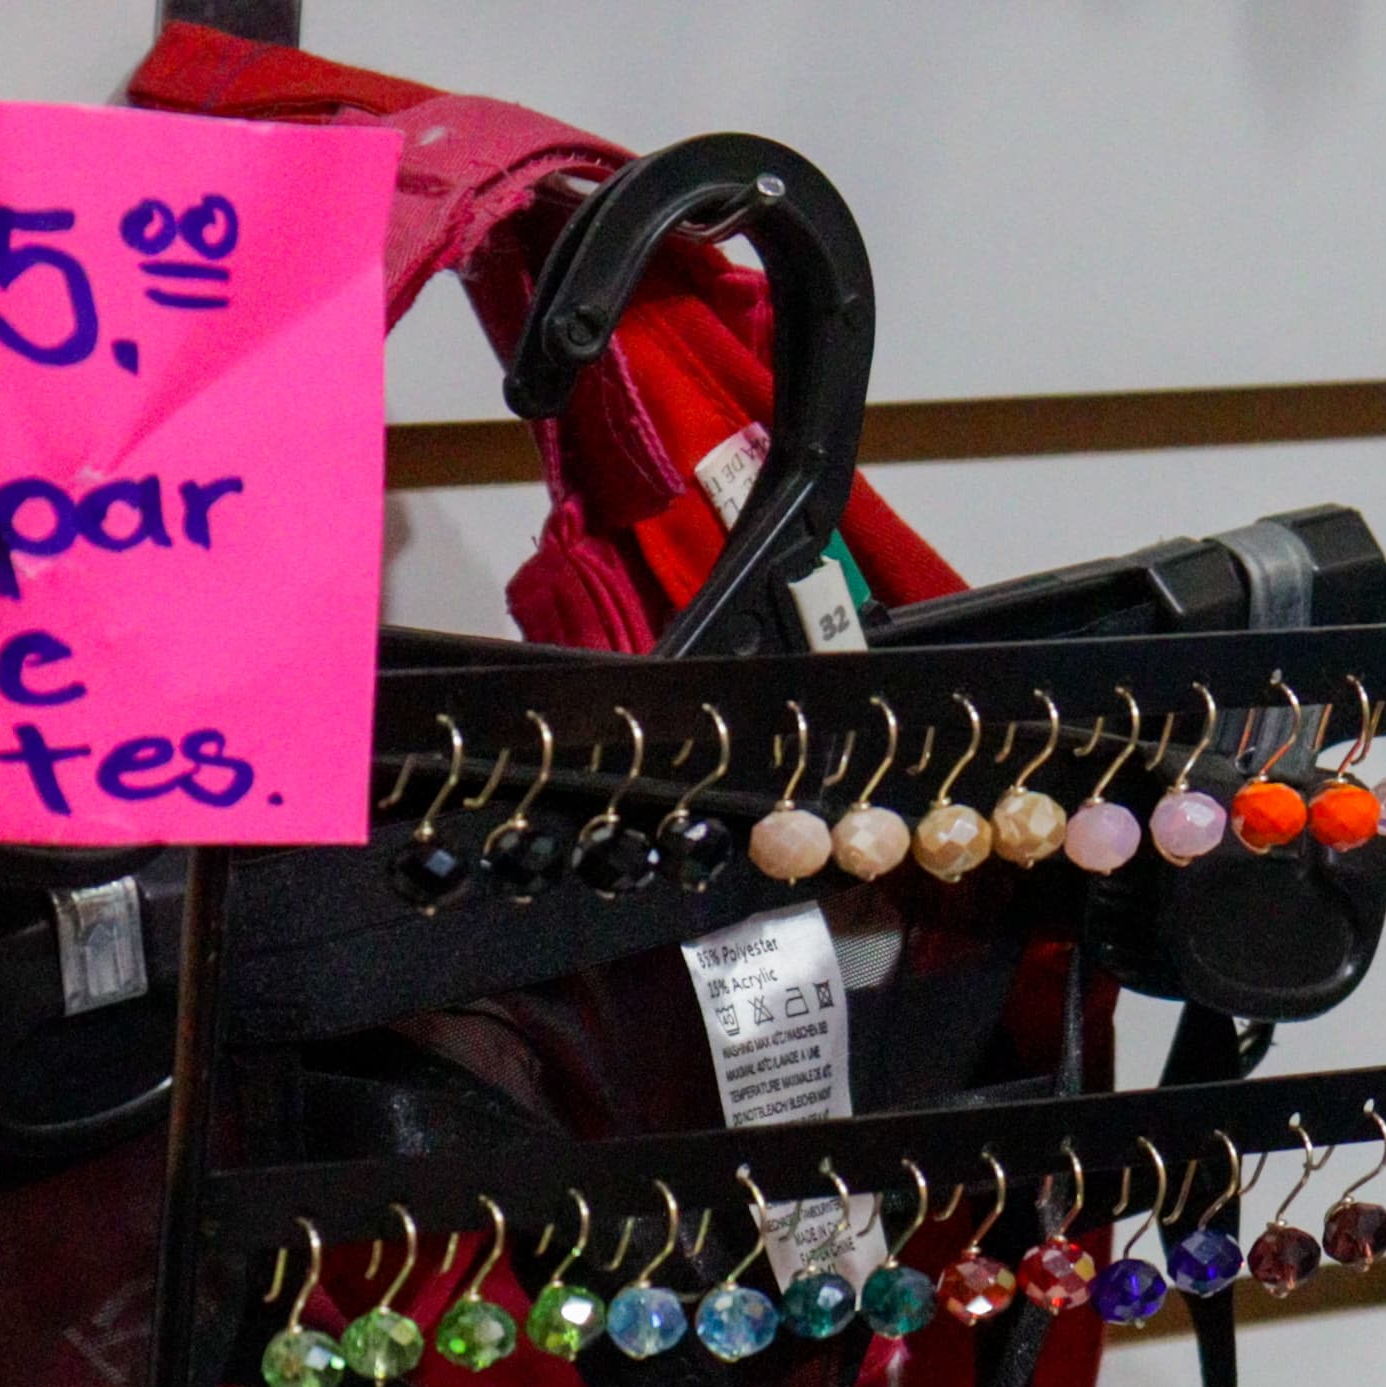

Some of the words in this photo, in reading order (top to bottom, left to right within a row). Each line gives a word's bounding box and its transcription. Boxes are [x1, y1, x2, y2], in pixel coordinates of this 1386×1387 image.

[818, 604, 850, 642] 32
[721, 938, 778, 965] Polyester
[732, 967, 778, 992] Acrylic
